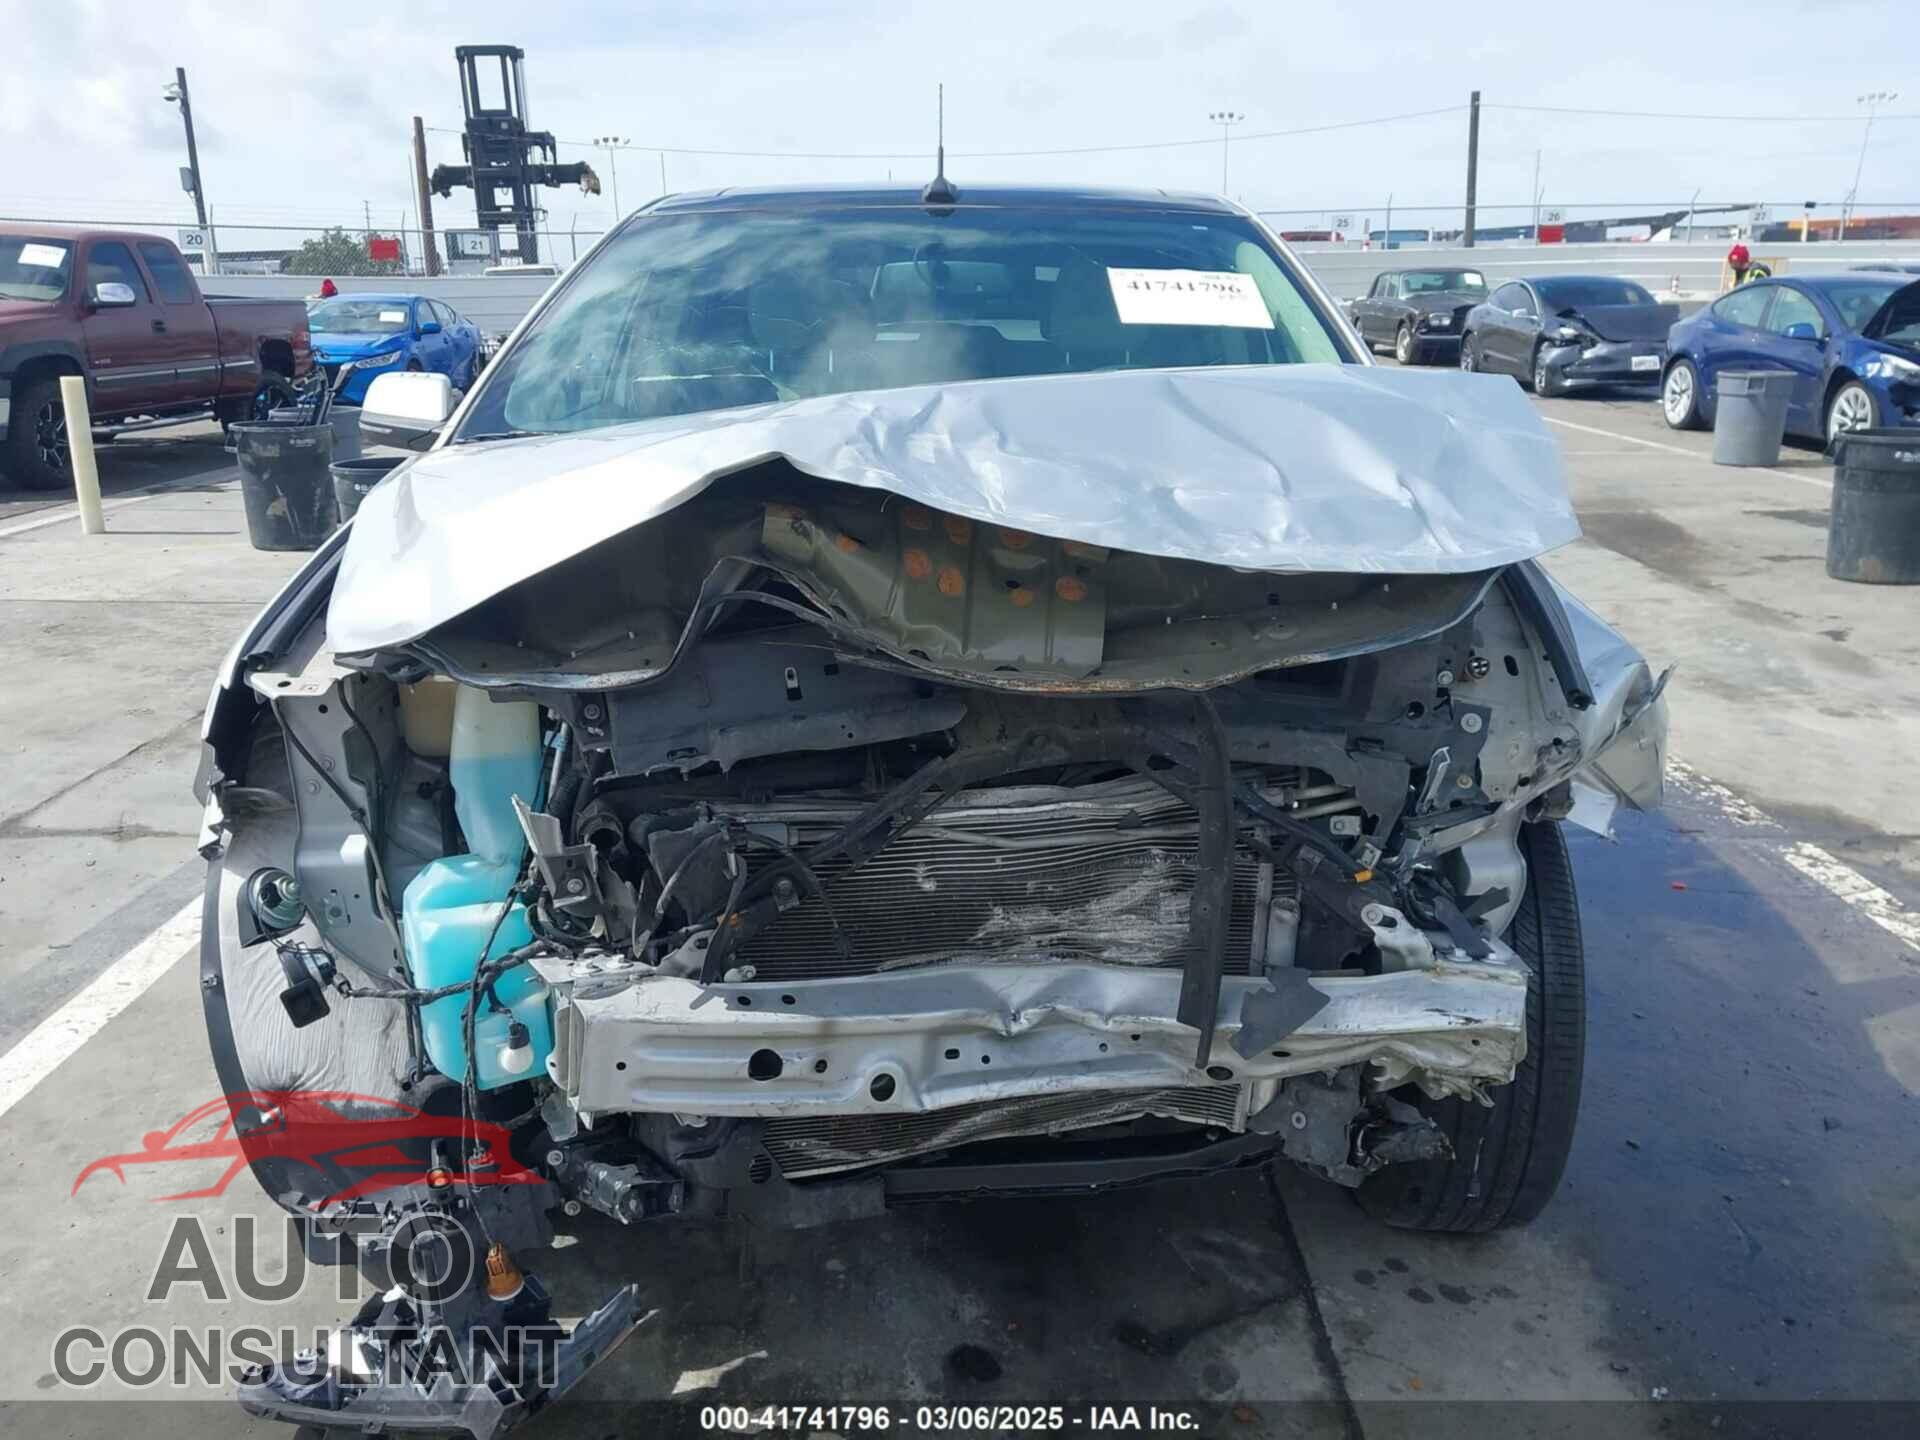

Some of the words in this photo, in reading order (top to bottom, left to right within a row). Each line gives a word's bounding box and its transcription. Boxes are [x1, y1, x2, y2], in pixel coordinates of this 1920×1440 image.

[1336, 217, 1350, 228] 25
[186, 234, 203, 245] 20
[471, 240, 483, 250] 21
[1127, 280, 1242, 294] 41741796
